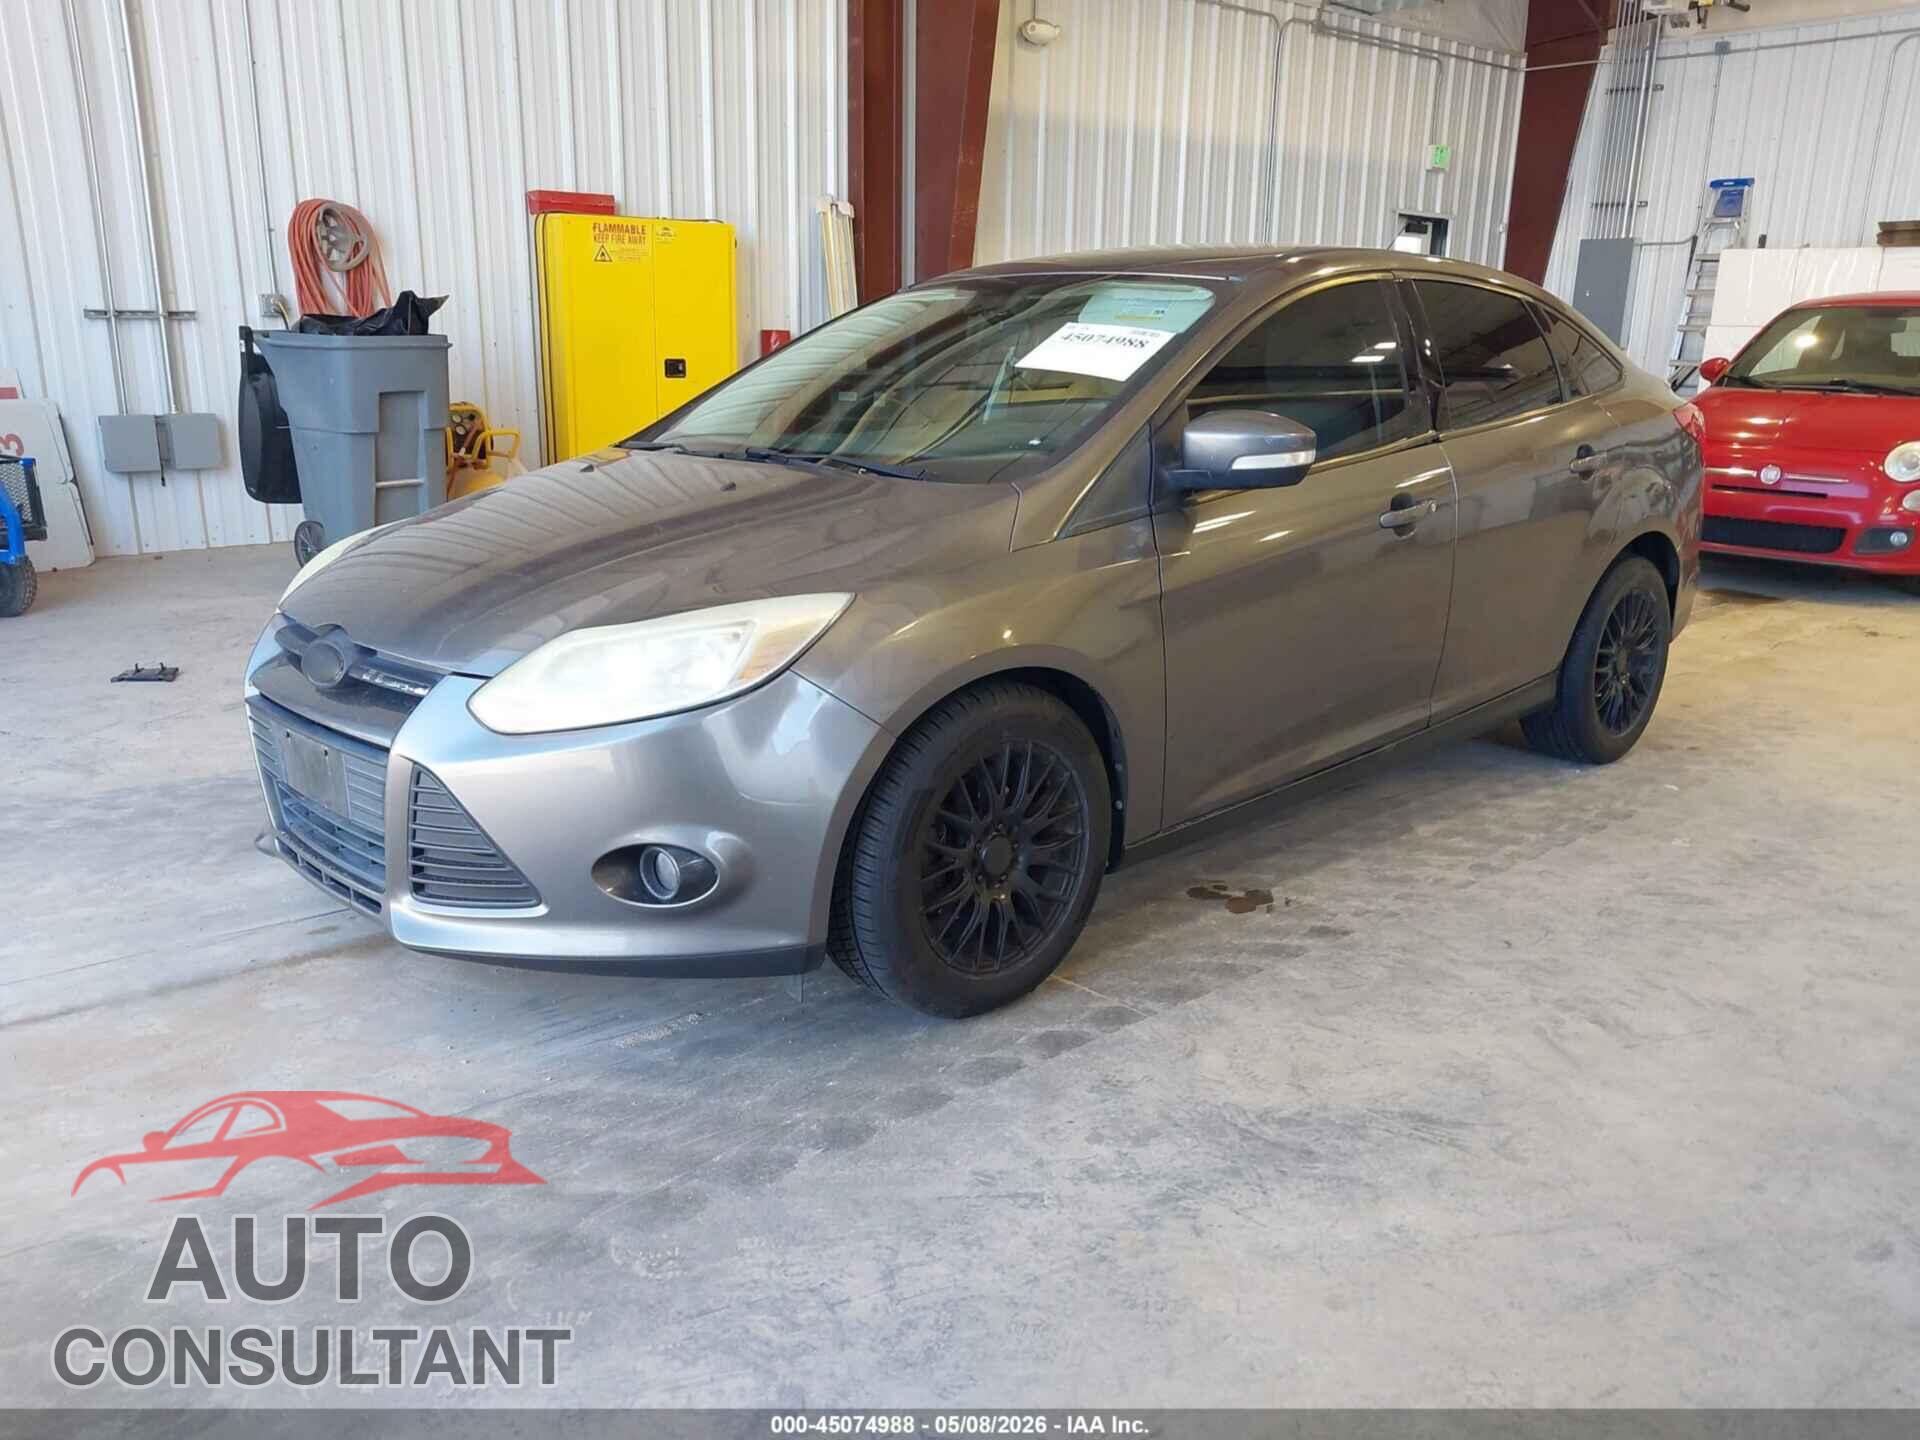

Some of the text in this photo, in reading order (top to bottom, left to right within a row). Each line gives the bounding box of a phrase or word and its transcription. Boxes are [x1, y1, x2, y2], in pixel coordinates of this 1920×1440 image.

[592, 222, 647, 236] FLAMMABLE
[593, 232, 610, 244] KEEP
[611, 233, 626, 245] FIRE
[628, 235, 646, 247] AWAY
[1061, 332, 1150, 349] 45074988
